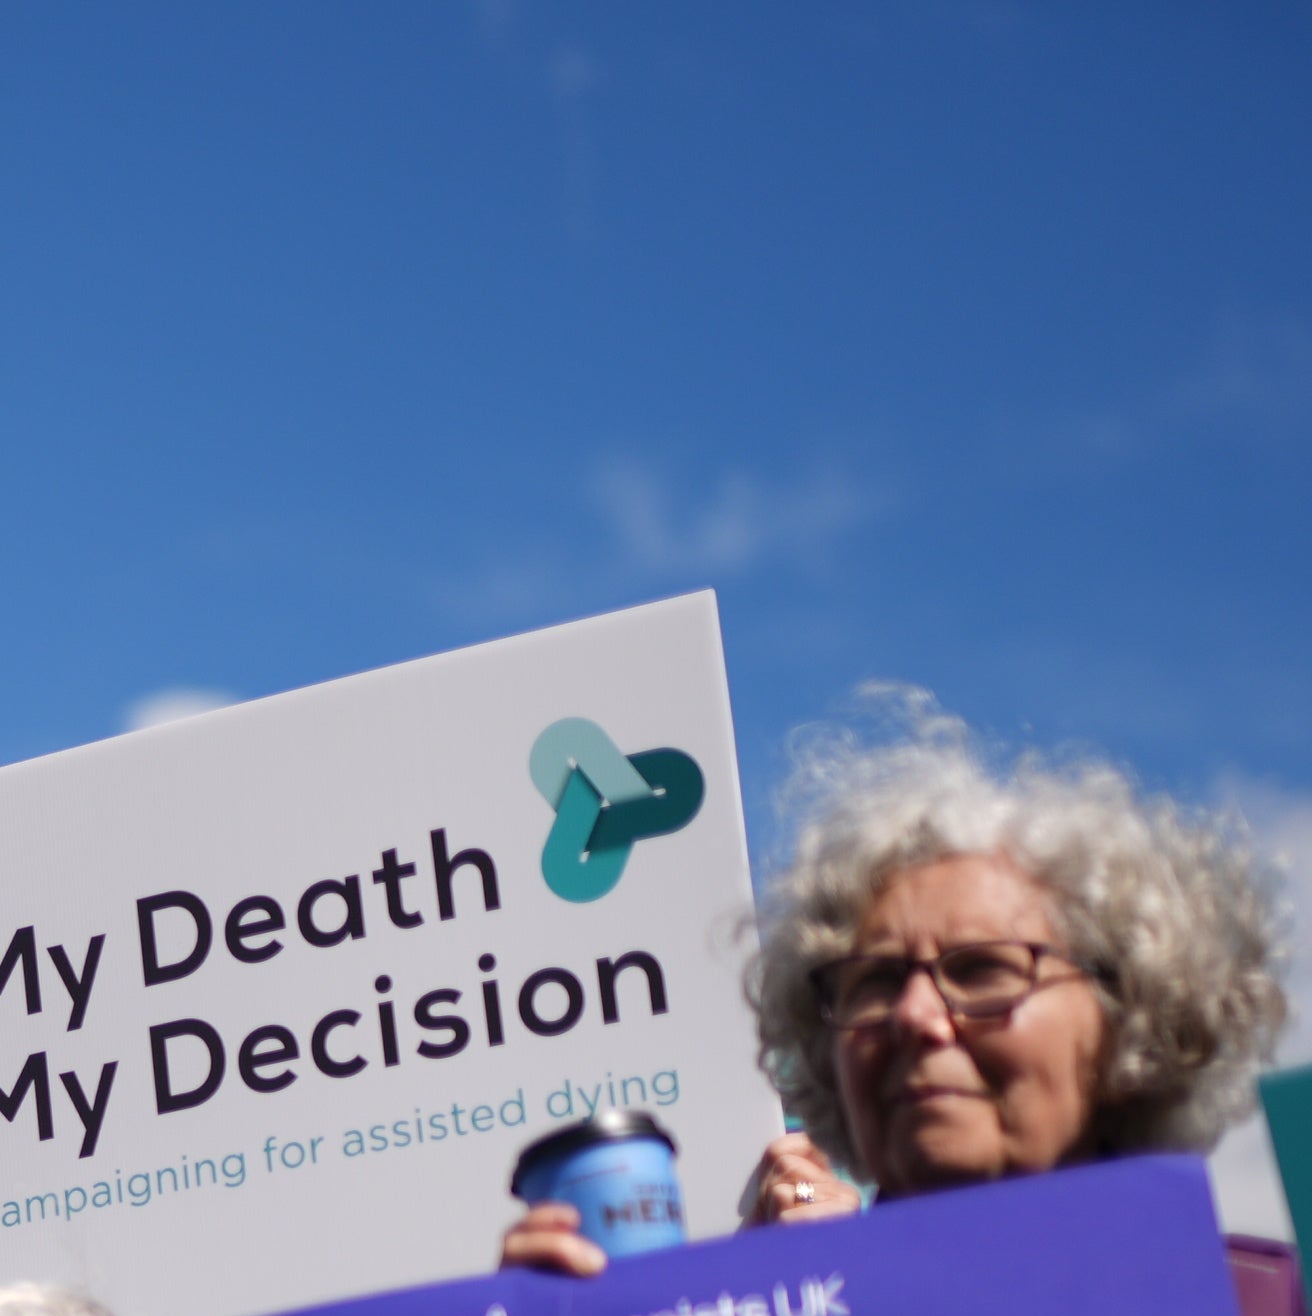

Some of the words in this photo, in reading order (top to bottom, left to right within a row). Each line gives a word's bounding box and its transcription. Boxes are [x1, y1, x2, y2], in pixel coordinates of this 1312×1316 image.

[136, 827, 502, 987] Death
[149, 949, 670, 1116] Decision
[263, 1136, 326, 1173] for
[342, 1089, 527, 1159] assisted
[546, 1068, 682, 1120] dying
